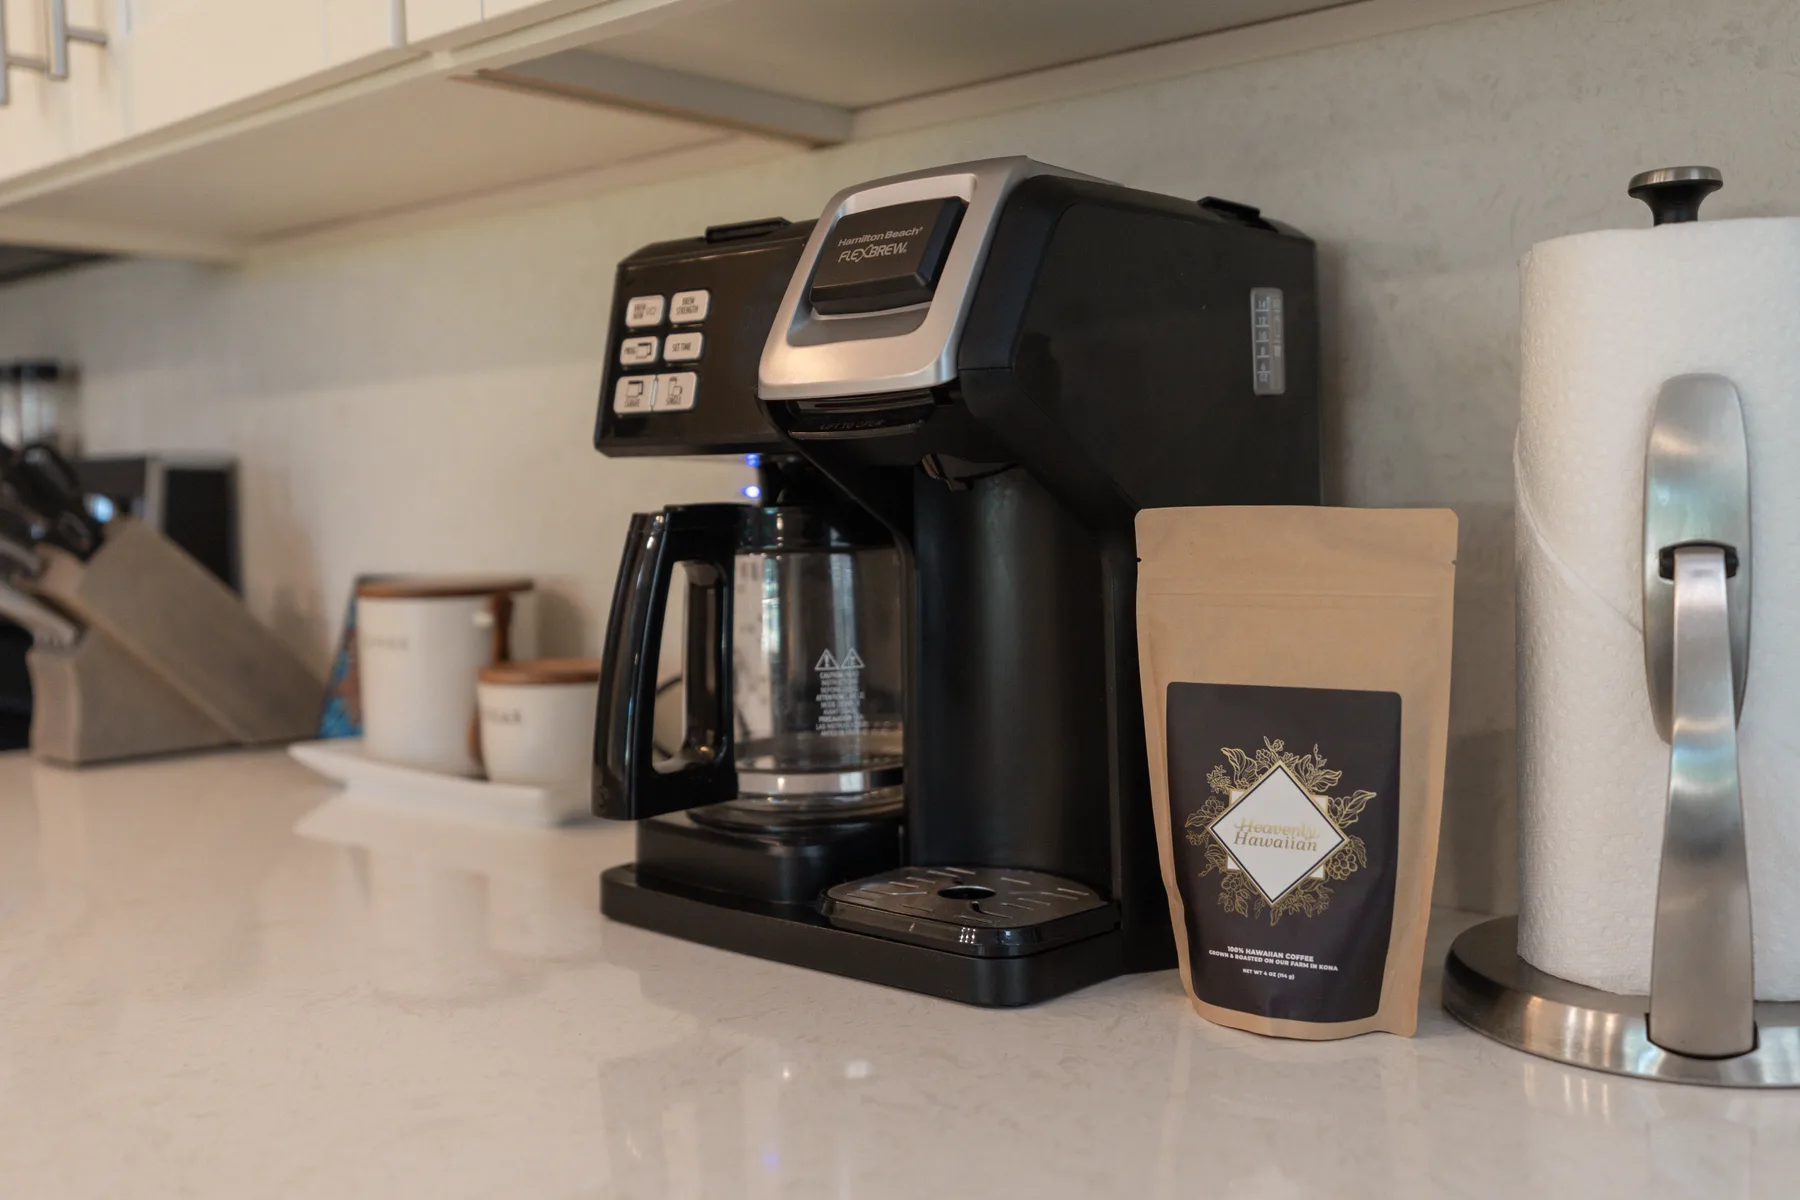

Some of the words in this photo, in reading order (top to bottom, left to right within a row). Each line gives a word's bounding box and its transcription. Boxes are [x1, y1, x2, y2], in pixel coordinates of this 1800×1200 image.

[838, 233, 884, 247] Hamilton
[838, 241, 908, 262] FLEXBREW
[676, 304, 698, 315] STRENGTH
[1234, 817, 1320, 840] Heavenly
[1234, 831, 1318, 851] Hawaiian
[1208, 949, 1229, 958] GROWN
[1235, 954, 1263, 963] ROASTED
[1264, 957, 1274, 965] ON
[1275, 958, 1289, 966] OUR
[1290, 960, 1309, 968] FARM
[1227, 945, 1244, 954] 100%
[1245, 948, 1284, 958] HAWAIIAN
[1285, 953, 1314, 962] COFFEE
